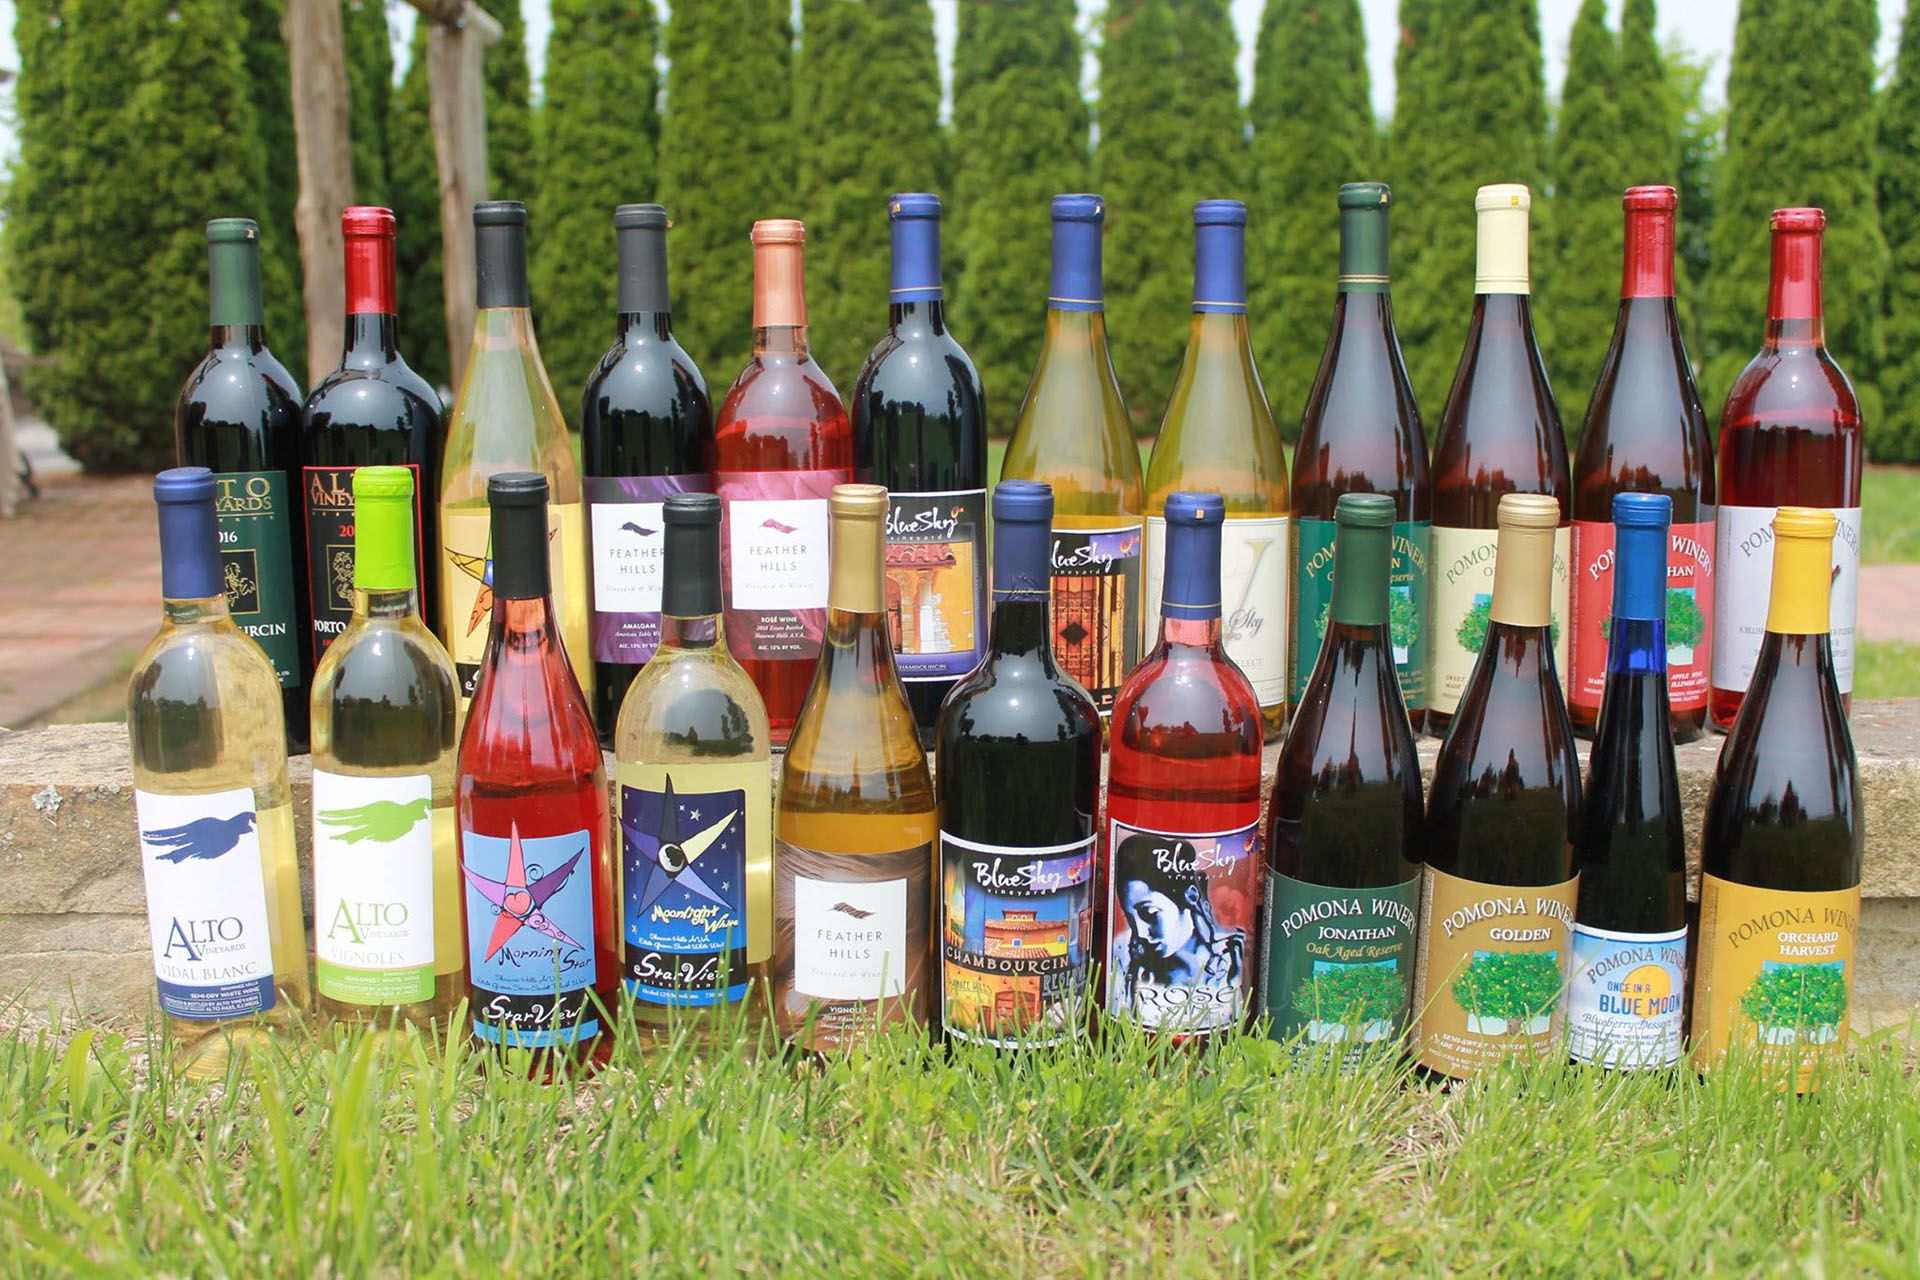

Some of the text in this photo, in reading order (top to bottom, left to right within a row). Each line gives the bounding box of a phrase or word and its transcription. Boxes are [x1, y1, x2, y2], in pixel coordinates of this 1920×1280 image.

[217, 477, 270, 497] TO
[311, 473, 354, 493] AL
[215, 496, 272, 511] YARDS
[312, 492, 354, 507] VINEY
[339, 525, 354, 537] 20
[1740, 523, 1774, 557] POM
[749, 545, 807, 556] FEATHER
[1052, 540, 1113, 573] lueSky
[1305, 540, 1337, 579] POM
[1672, 535, 1712, 577] WINERY
[620, 564, 657, 574] HILLS
[760, 561, 798, 571] HILLS
[1446, 543, 1497, 585] POMON
[1229, 606, 1264, 638] Sky
[1152, 843, 1236, 876] BlueSky
[972, 857, 1063, 893] BlueSky
[987, 888, 1046, 896] vineyard
[328, 897, 408, 944] ALTO
[651, 905, 720, 925] Moonlight
[1281, 898, 1417, 938] POMONA WINERY
[1442, 898, 1528, 937] POMONA
[817, 929, 882, 941] FEATHER
[1318, 925, 1397, 940] JONATHAN
[1489, 927, 1551, 942] GOLDEN
[1728, 907, 1814, 949] POMONA
[1777, 931, 1839, 943] ORCHARD
[163, 916, 243, 961] ALTO
[331, 945, 406, 964] VIGNOLES
[829, 948, 870, 959] HILLS
[1306, 942, 1403, 960] Oak Aged Reserve
[1779, 944, 1837, 956] HARVEST
[160, 961, 257, 980] VIDAL BLANC
[559, 949, 592, 972] Star
[946, 946, 1069, 975] CHAMBOURCIN
[1587, 946, 1654, 984] POMONA
[1607, 981, 1650, 992] ONCE IN A
[482, 995, 583, 1023] StarVew
[1599, 993, 1680, 1015] BLUE MOON
